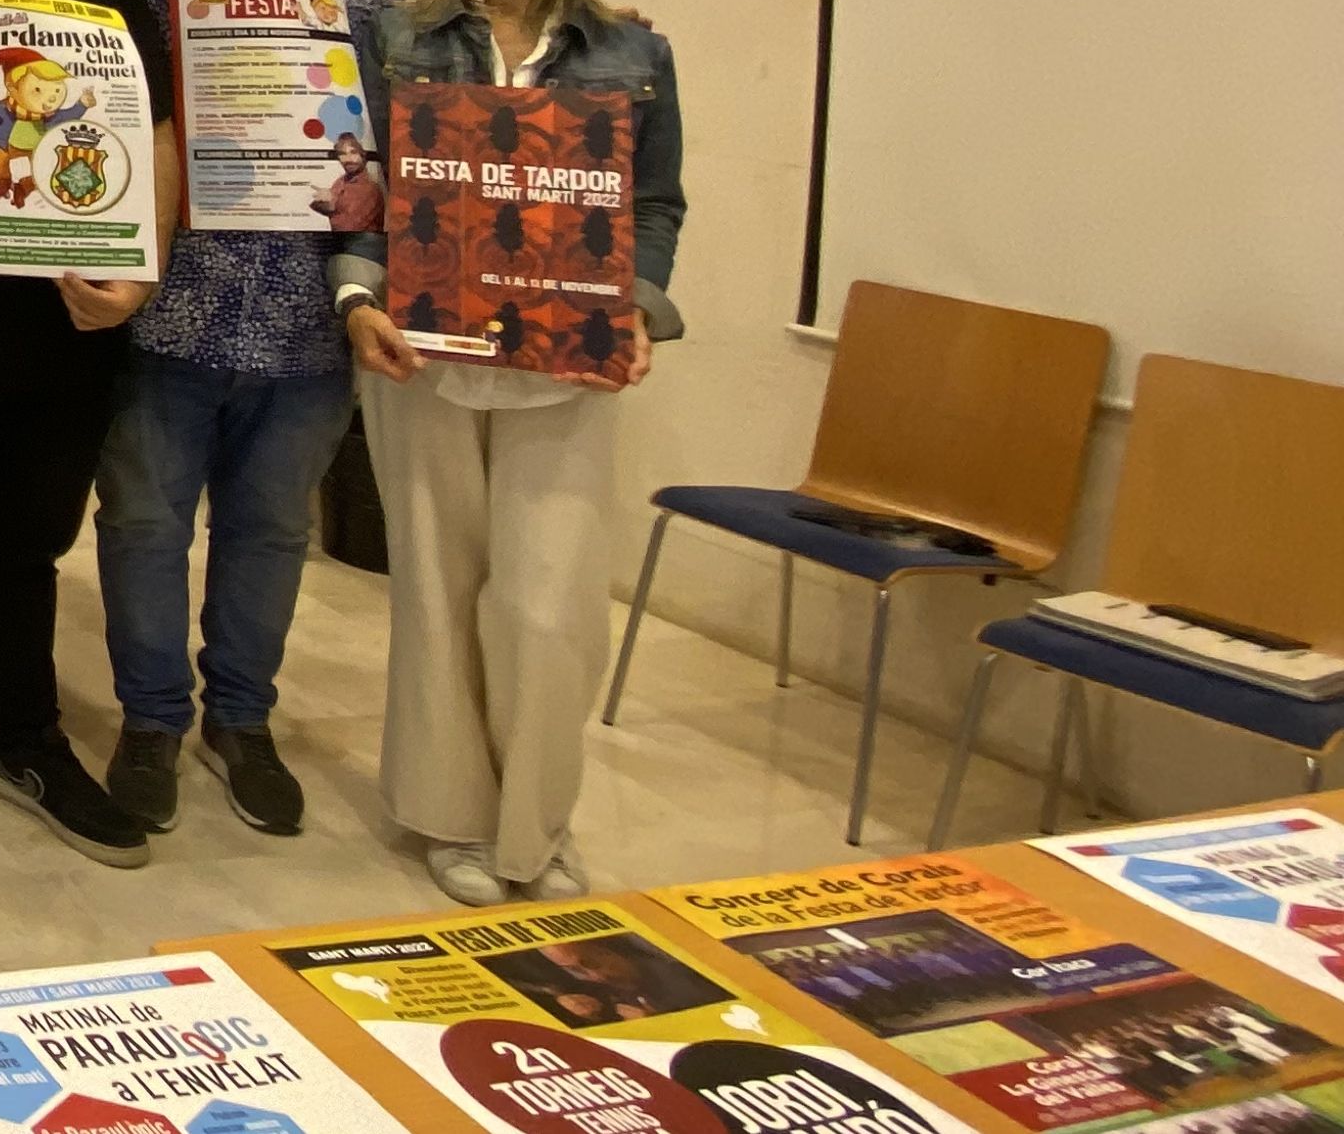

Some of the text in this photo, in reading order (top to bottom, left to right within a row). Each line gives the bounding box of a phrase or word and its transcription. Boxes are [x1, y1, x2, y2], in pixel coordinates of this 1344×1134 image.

[86, 50, 125, 65] Club
[400, 157, 622, 193] FESTA DE TARDOR
[482, 184, 621, 208] SANT MARTÍ 2022
[481, 273, 502, 285] DEL
[513, 276, 527, 287] AL
[543, 279, 558, 290] DE
[561, 280, 622, 296] NOVEMBRE
[684, 864, 964, 911] Concert de Corals
[721, 879, 985, 928] de la Festa de Tardor
[435, 909, 626, 953] FESTA DE TARDOR
[308, 942, 434, 961] SANT MARTÍ 2022
[48, 982, 82, 999] SANT
[86, 977, 126, 994] MARTÍ
[126, 973, 162, 990] 2022
[17, 1002, 163, 1034] MATINAL de
[491, 1040, 571, 1074] 2n
[12, 1070, 48, 1085] matí
[112, 1052, 302, 1102] a L'ENVELAT
[489, 1066, 653, 1115] TORNEIG
[697, 1069, 865, 1134] JORDI
